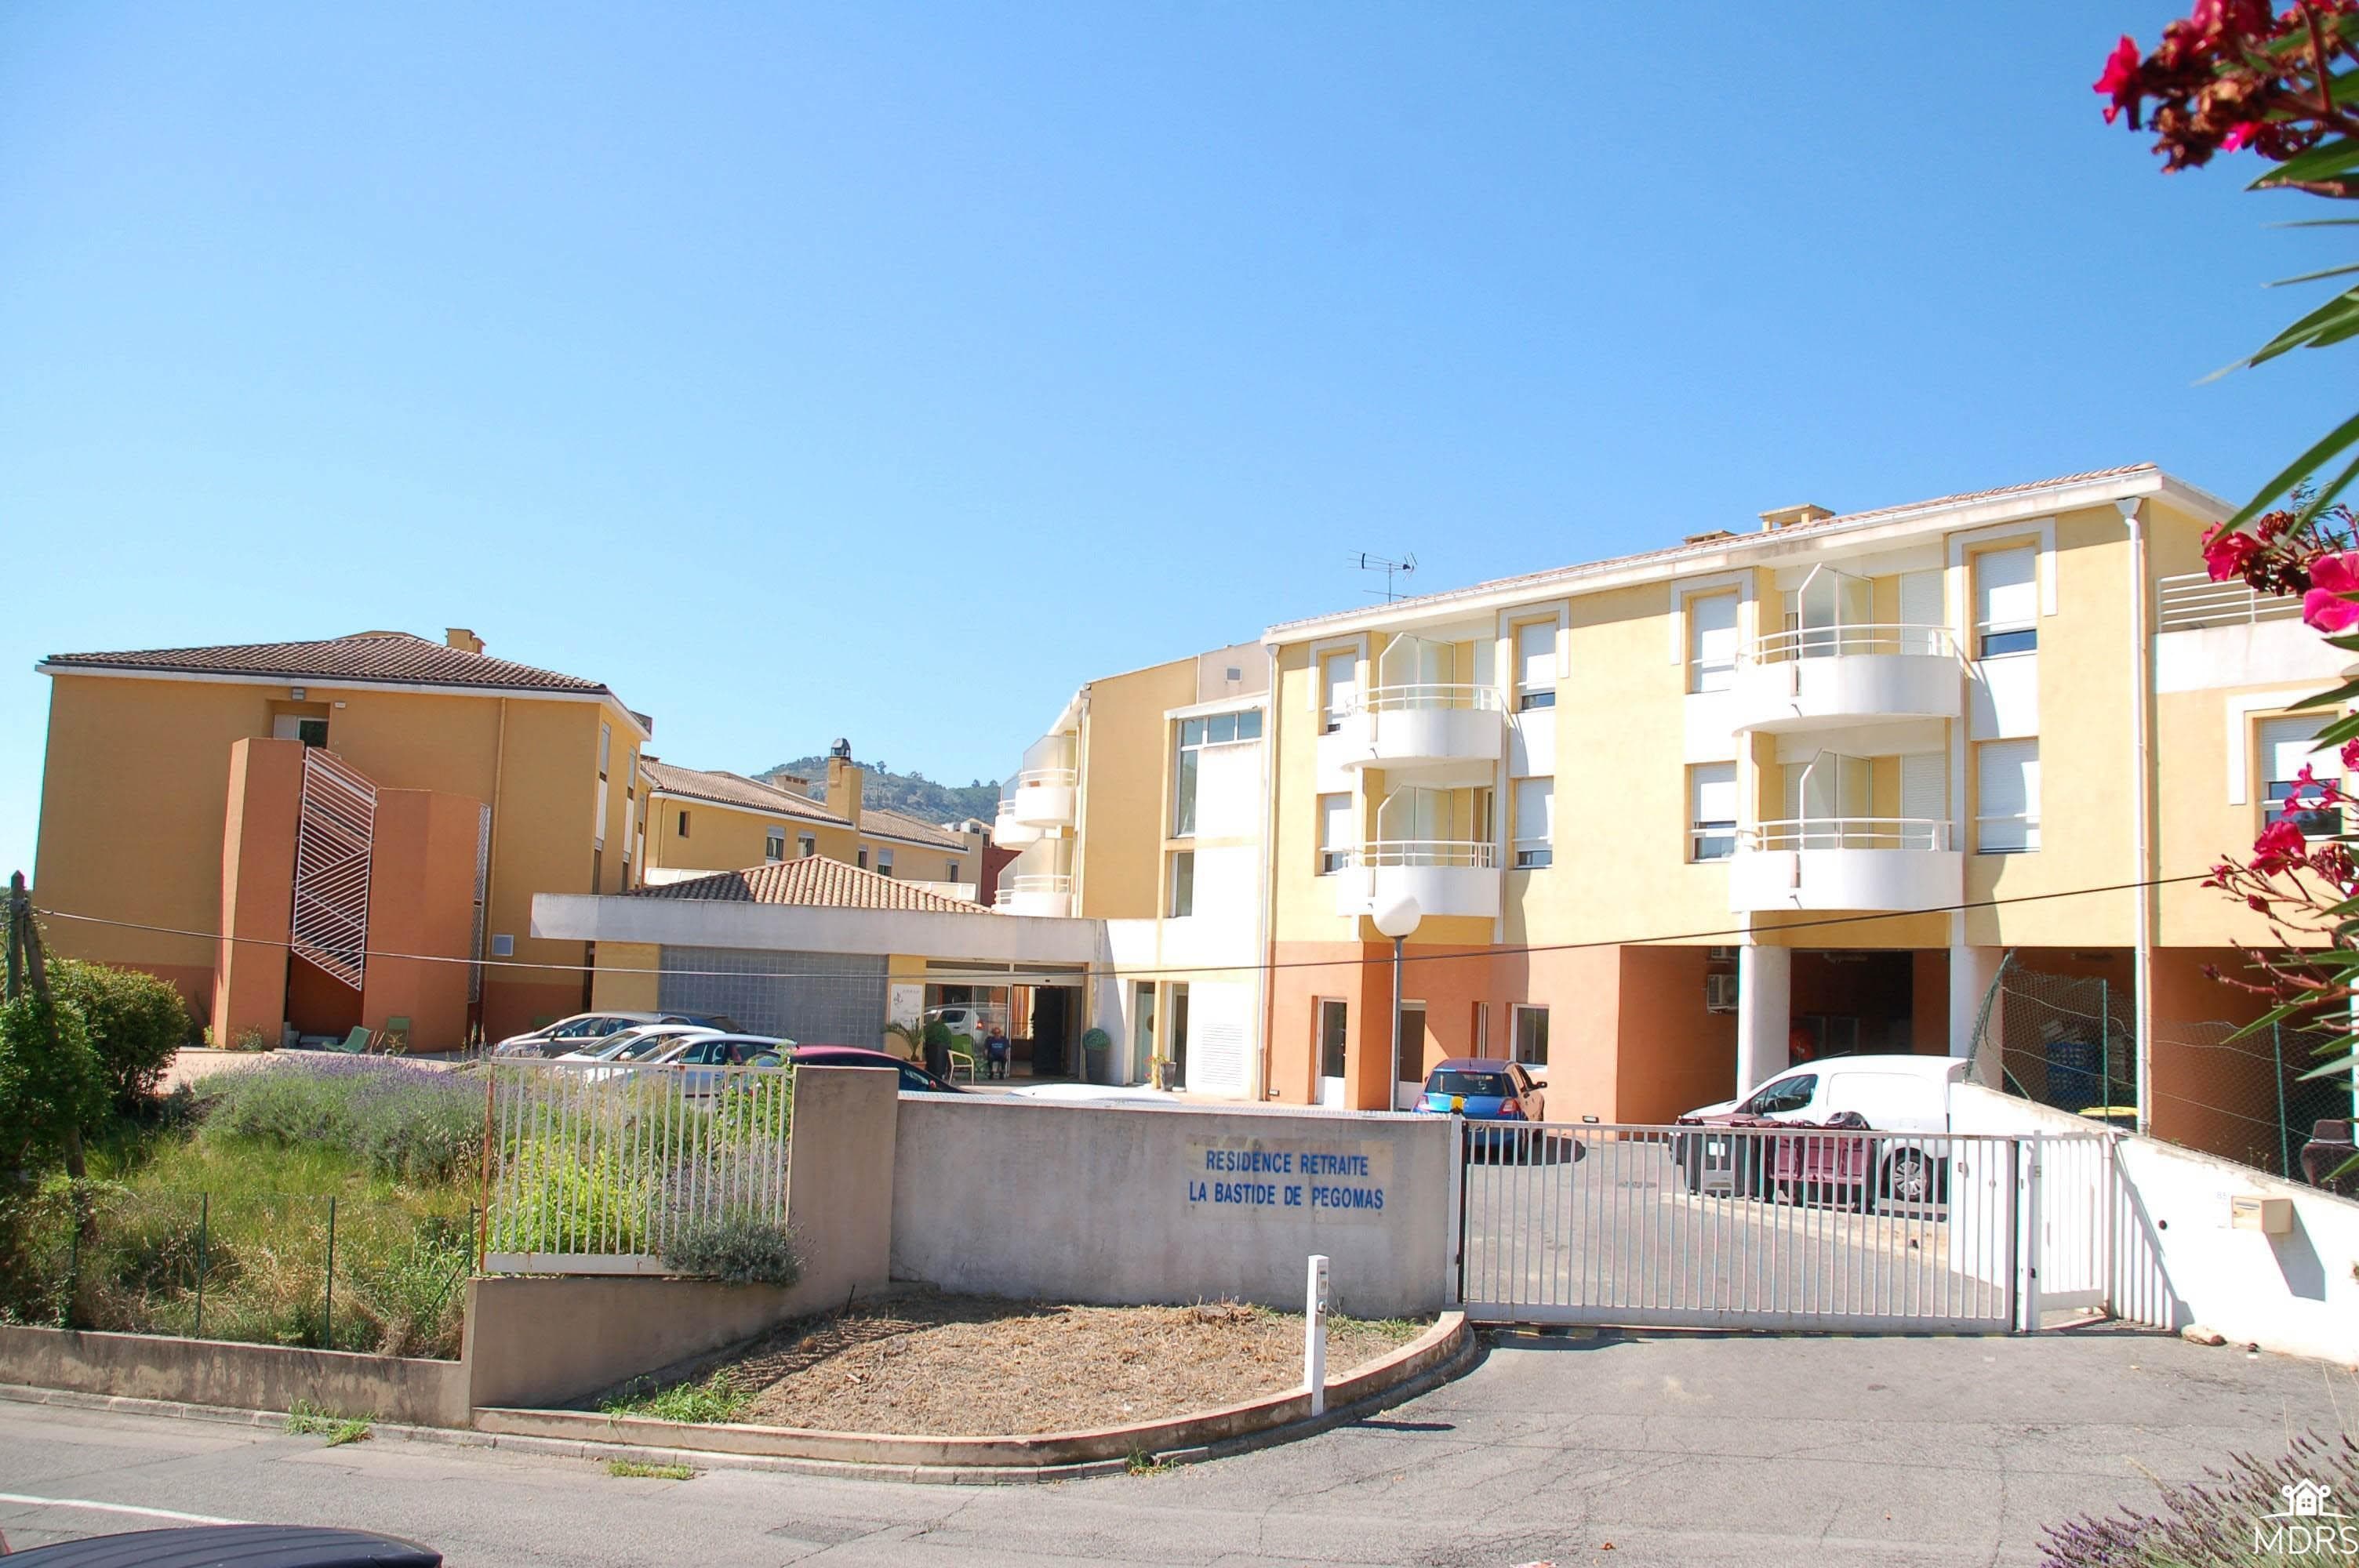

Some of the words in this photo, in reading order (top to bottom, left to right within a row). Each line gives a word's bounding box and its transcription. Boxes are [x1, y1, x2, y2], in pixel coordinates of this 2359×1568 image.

[1206, 1150, 1292, 1174] RESIDENCE
[1300, 1154, 1369, 1176] RETRAITE
[1189, 1181, 1207, 1202] LA
[1214, 1182, 1276, 1205] BASTIDE
[1284, 1185, 1303, 1206] DE
[1311, 1186, 1383, 1209] PEGOMAS
